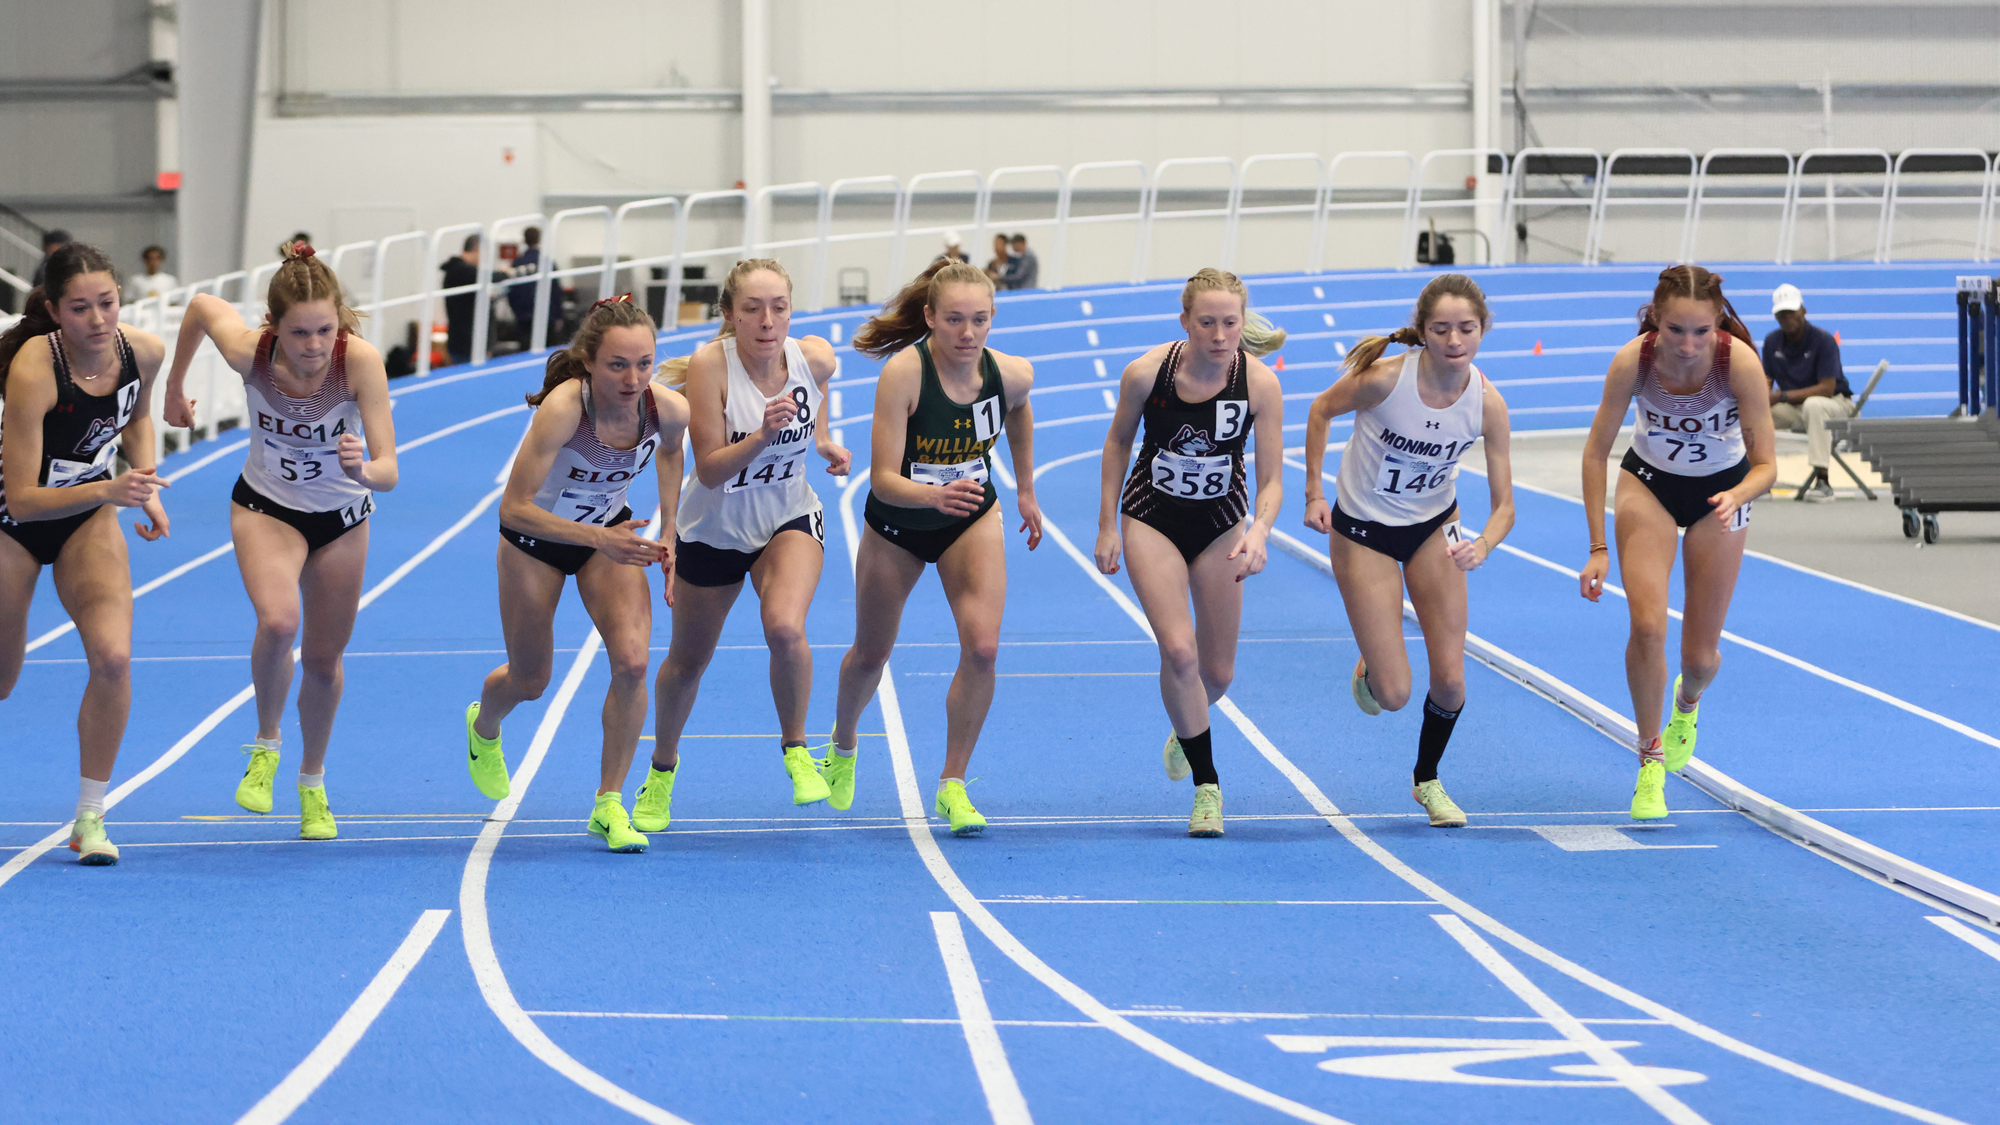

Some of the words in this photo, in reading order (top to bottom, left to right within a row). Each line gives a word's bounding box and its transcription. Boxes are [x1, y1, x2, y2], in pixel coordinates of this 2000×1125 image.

[793, 386, 811, 424] 8
[981, 401, 995, 436] 1
[1708, 406, 1739, 432] 15
[258, 411, 312, 439] ELO
[313, 418, 347, 442] 14
[1222, 403, 1241, 438] 3
[1646, 410, 1704, 433] ELO
[1666, 438, 1707, 463] 73
[281, 457, 323, 481] 53
[567, 466, 638, 483] ELO
[732, 460, 795, 488] 141
[1157, 466, 1224, 496] 258
[1383, 466, 1449, 494] 146
[344, 495, 372, 523] 14
[814, 509, 825, 541] 8
